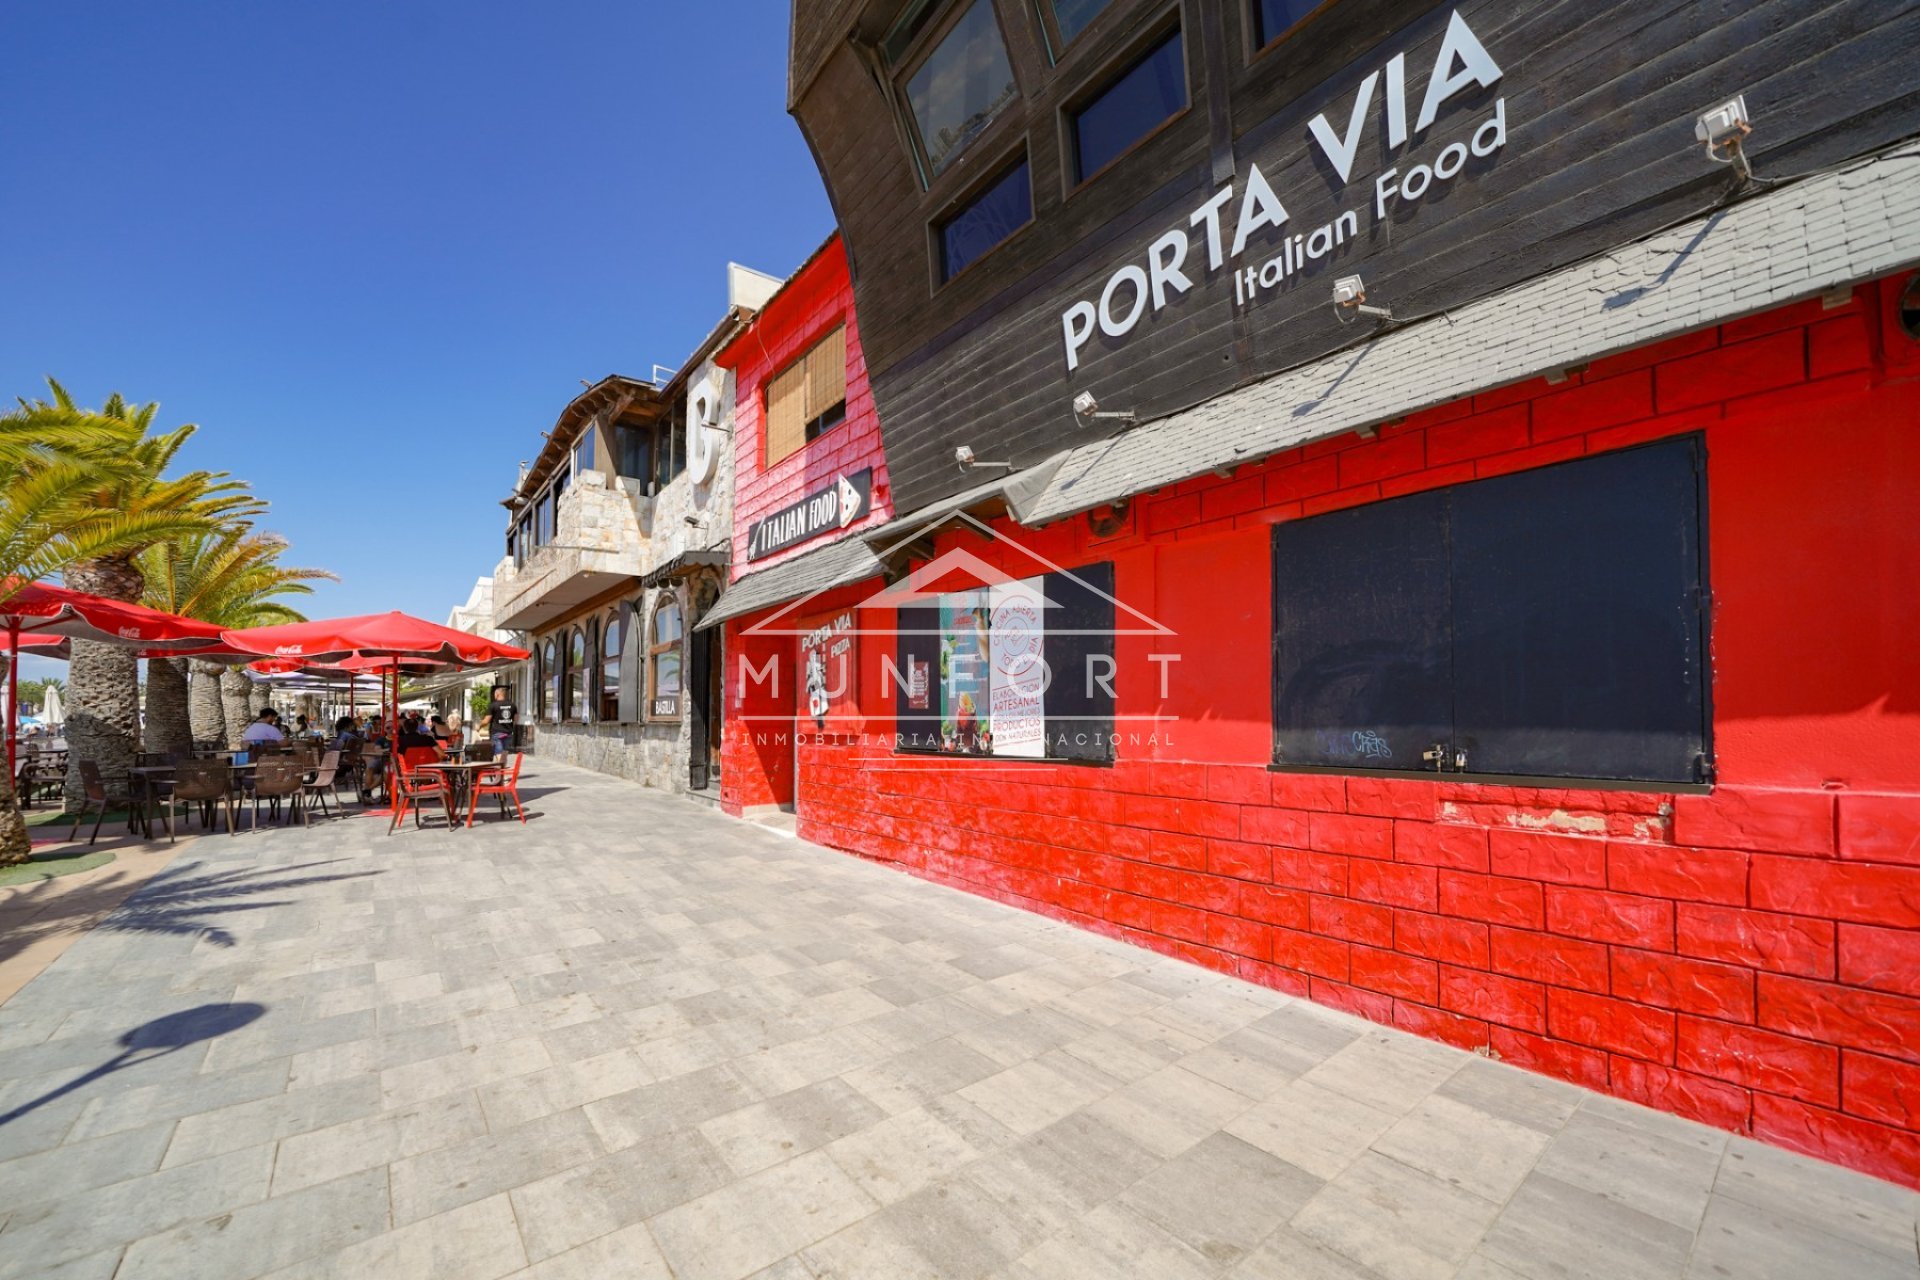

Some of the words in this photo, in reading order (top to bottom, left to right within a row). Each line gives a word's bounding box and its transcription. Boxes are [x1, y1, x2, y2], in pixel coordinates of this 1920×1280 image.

[1062, 163, 1289, 371] PORTA
[1307, 8, 1503, 184] VIA
[1234, 209, 1357, 305] Italian
[1376, 97, 1506, 219] Food
[761, 504, 806, 551] ITALIAN
[809, 490, 837, 532] FOOD
[802, 624, 832, 652] PORTA
[834, 612, 851, 634] VIA
[831, 637, 850, 658] PIZZA
[655, 700, 675, 715] BASTILLA
[993, 696, 1040, 713] ARTESANAL
[993, 717, 1041, 732] PRODUCTOS
